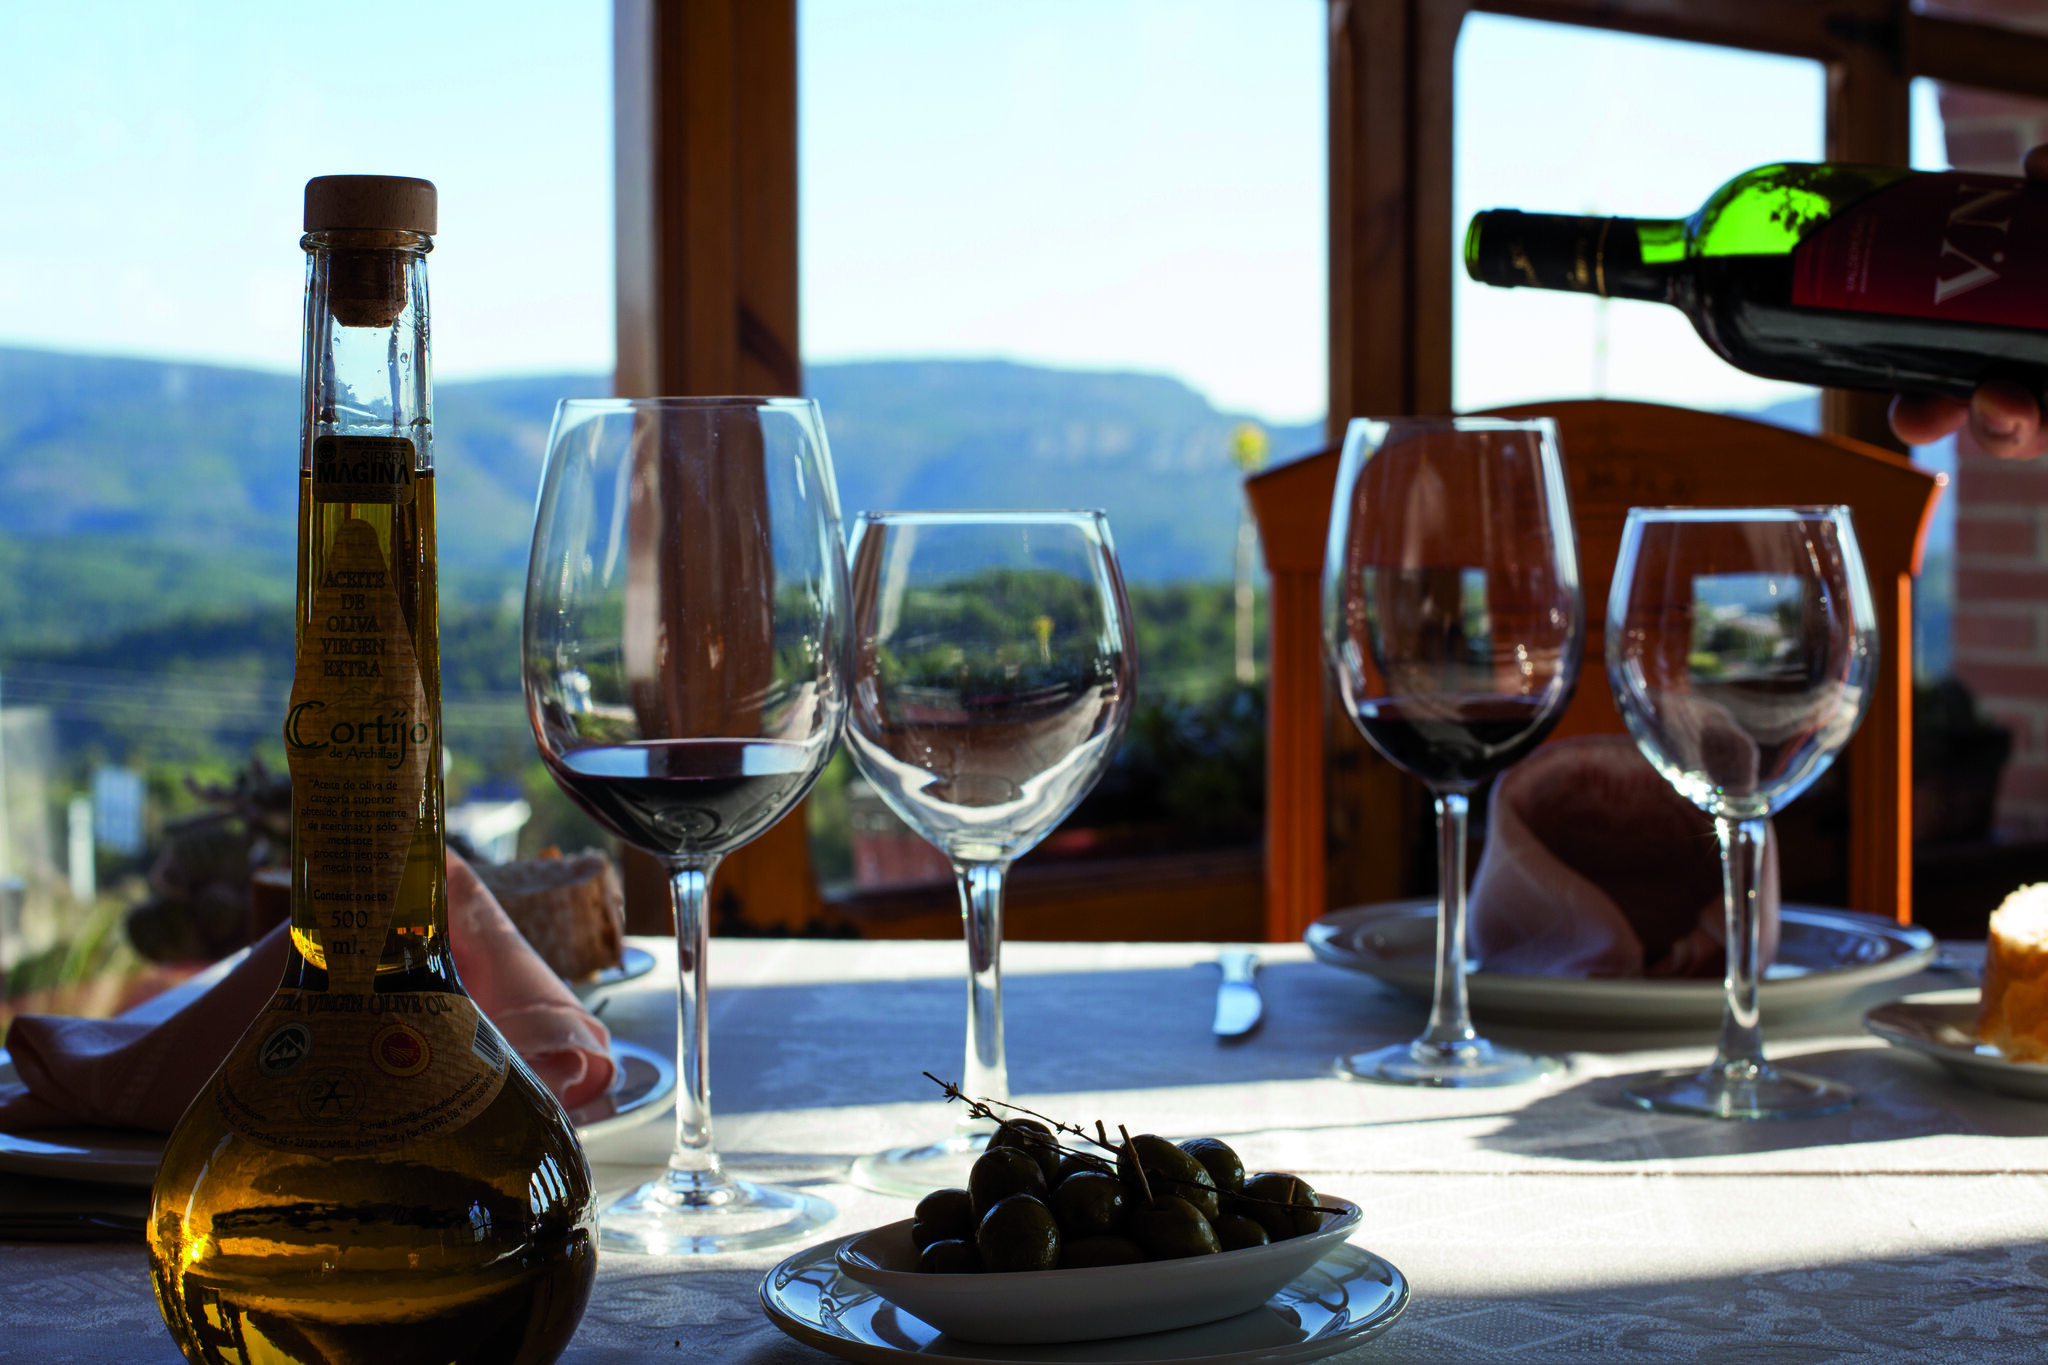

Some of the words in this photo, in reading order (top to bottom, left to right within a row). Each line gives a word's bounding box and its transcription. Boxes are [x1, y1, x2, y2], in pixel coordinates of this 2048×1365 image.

[344, 440, 372, 448] CONSEJO
[361, 450, 407, 465] SIERRA
[323, 570, 386, 589] ACEITE
[341, 593, 366, 611] DE
[326, 615, 381, 633] OLIVA
[320, 637, 387, 656] VIRGEN
[323, 659, 384, 678] EXTRA
[286, 700, 428, 770] Cortijo
[329, 745, 343, 759] de
[345, 745, 399, 761] Archillas
[343, 780, 356, 791] de
[359, 780, 383, 791] oliva
[386, 780, 399, 791] de
[310, 794, 350, 805] categoría
[353, 795, 397, 806] superior
[301, 806, 338, 817] obtenido
[341, 807, 407, 818] directamente
[308, 820, 319, 831] de
[320, 821, 364, 832] aceitunas
[367, 824, 373, 834] y
[376, 822, 398, 832] sólo
[327, 835, 373, 846] mediante
[314, 848, 389, 860] procedimientos
[313, 889, 362, 902] Contenido
[364, 891, 388, 902] neto
[330, 909, 368, 929] 500
[331, 934, 366, 955] ml.
[307, 993, 363, 1016] VIRGIN
[369, 994, 423, 1017] OLIVE
[425, 994, 452, 1016] OIL
[278, 1136, 289, 1145] 65
[294, 1138, 318, 1149] 23120
[319, 1139, 353, 1150] CAMBIL
[420, 1121, 435, 1133] 953
